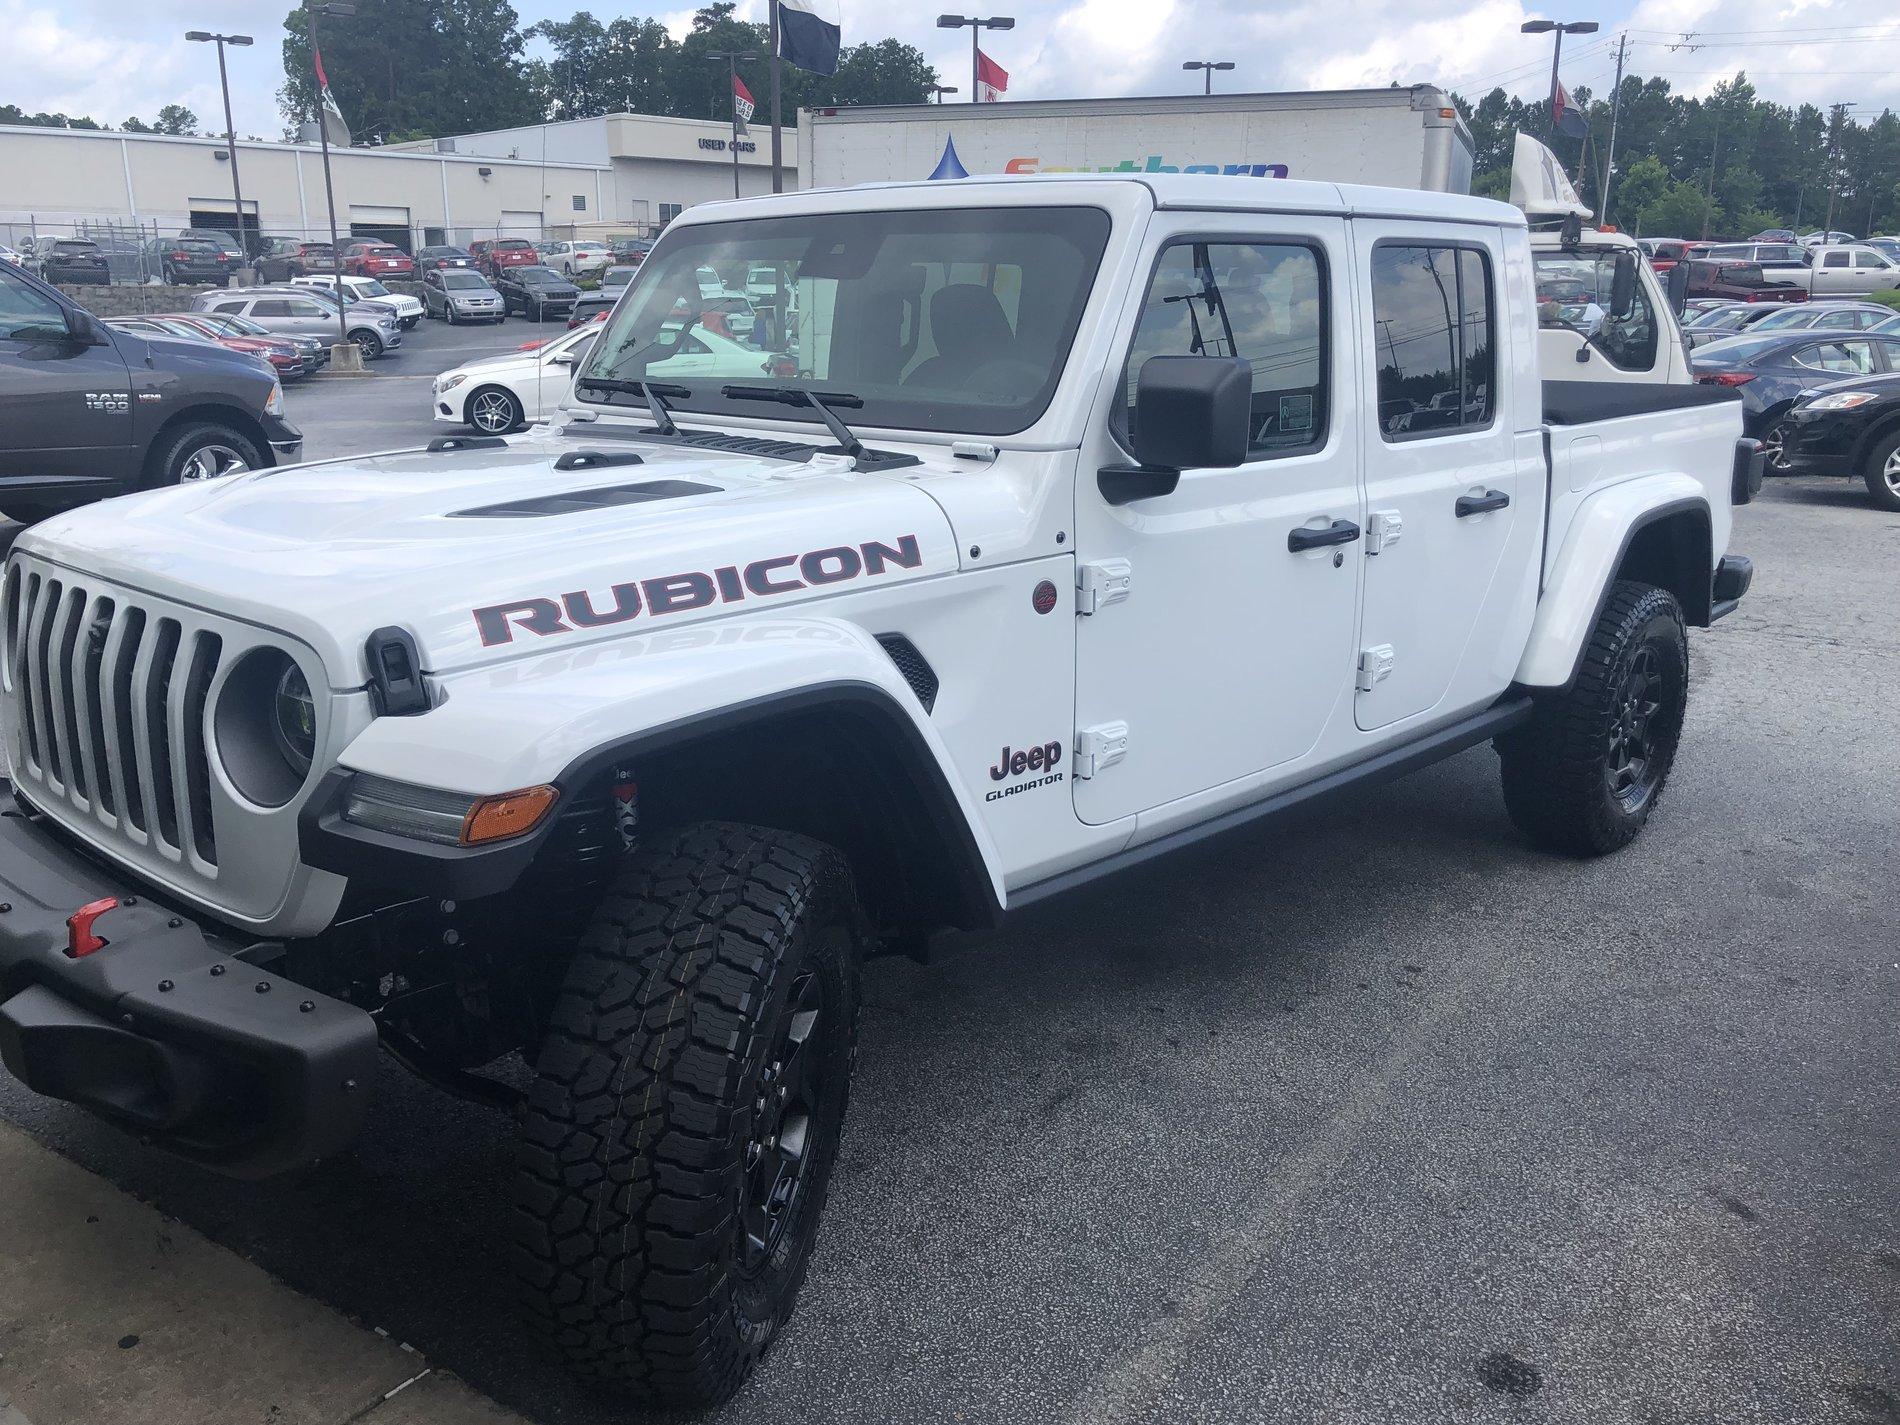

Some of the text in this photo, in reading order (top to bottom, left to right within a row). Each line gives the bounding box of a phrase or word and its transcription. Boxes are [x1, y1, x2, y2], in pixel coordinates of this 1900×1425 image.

[736, 97, 752, 111] SED
[698, 138, 756, 153] USED CARS
[1004, 155, 1289, 179] Sthrn
[85, 393, 128, 401] RAM
[86, 401, 129, 410] 1500
[472, 534, 923, 647] RUBICON
[989, 740, 1062, 781] Jeep
[985, 772, 1063, 802] GLADIATOR
